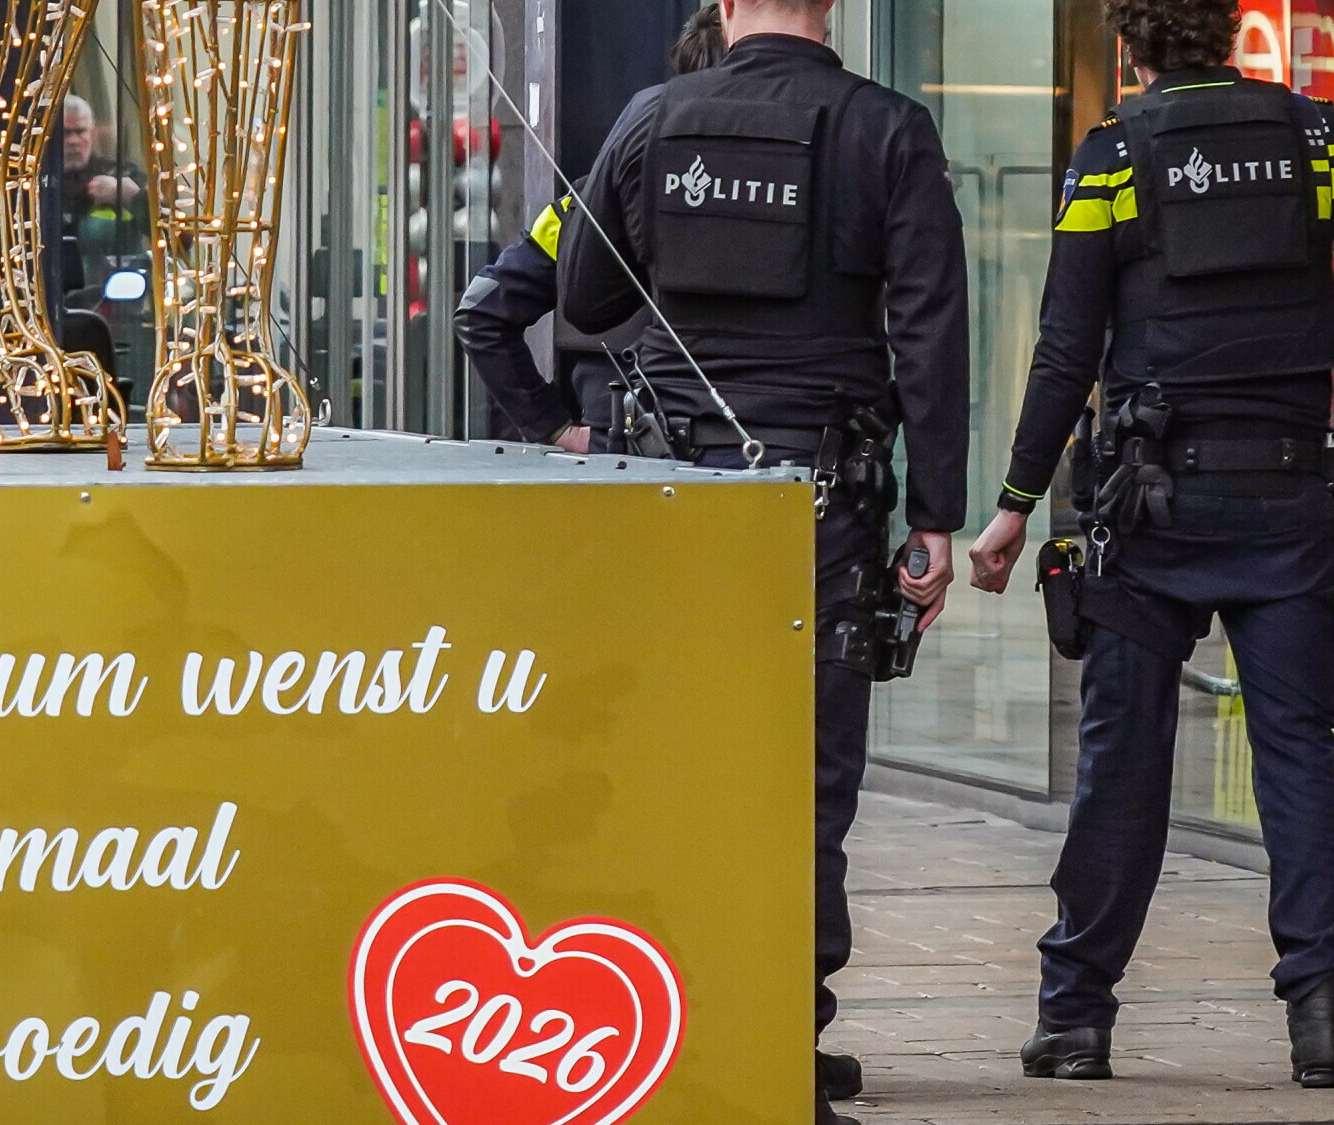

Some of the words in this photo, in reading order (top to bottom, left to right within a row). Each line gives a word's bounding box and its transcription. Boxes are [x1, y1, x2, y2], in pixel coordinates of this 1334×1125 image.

[181, 625, 453, 716] wenst
[477, 648, 549, 714] u
[404, 979, 621, 1094] 2026
